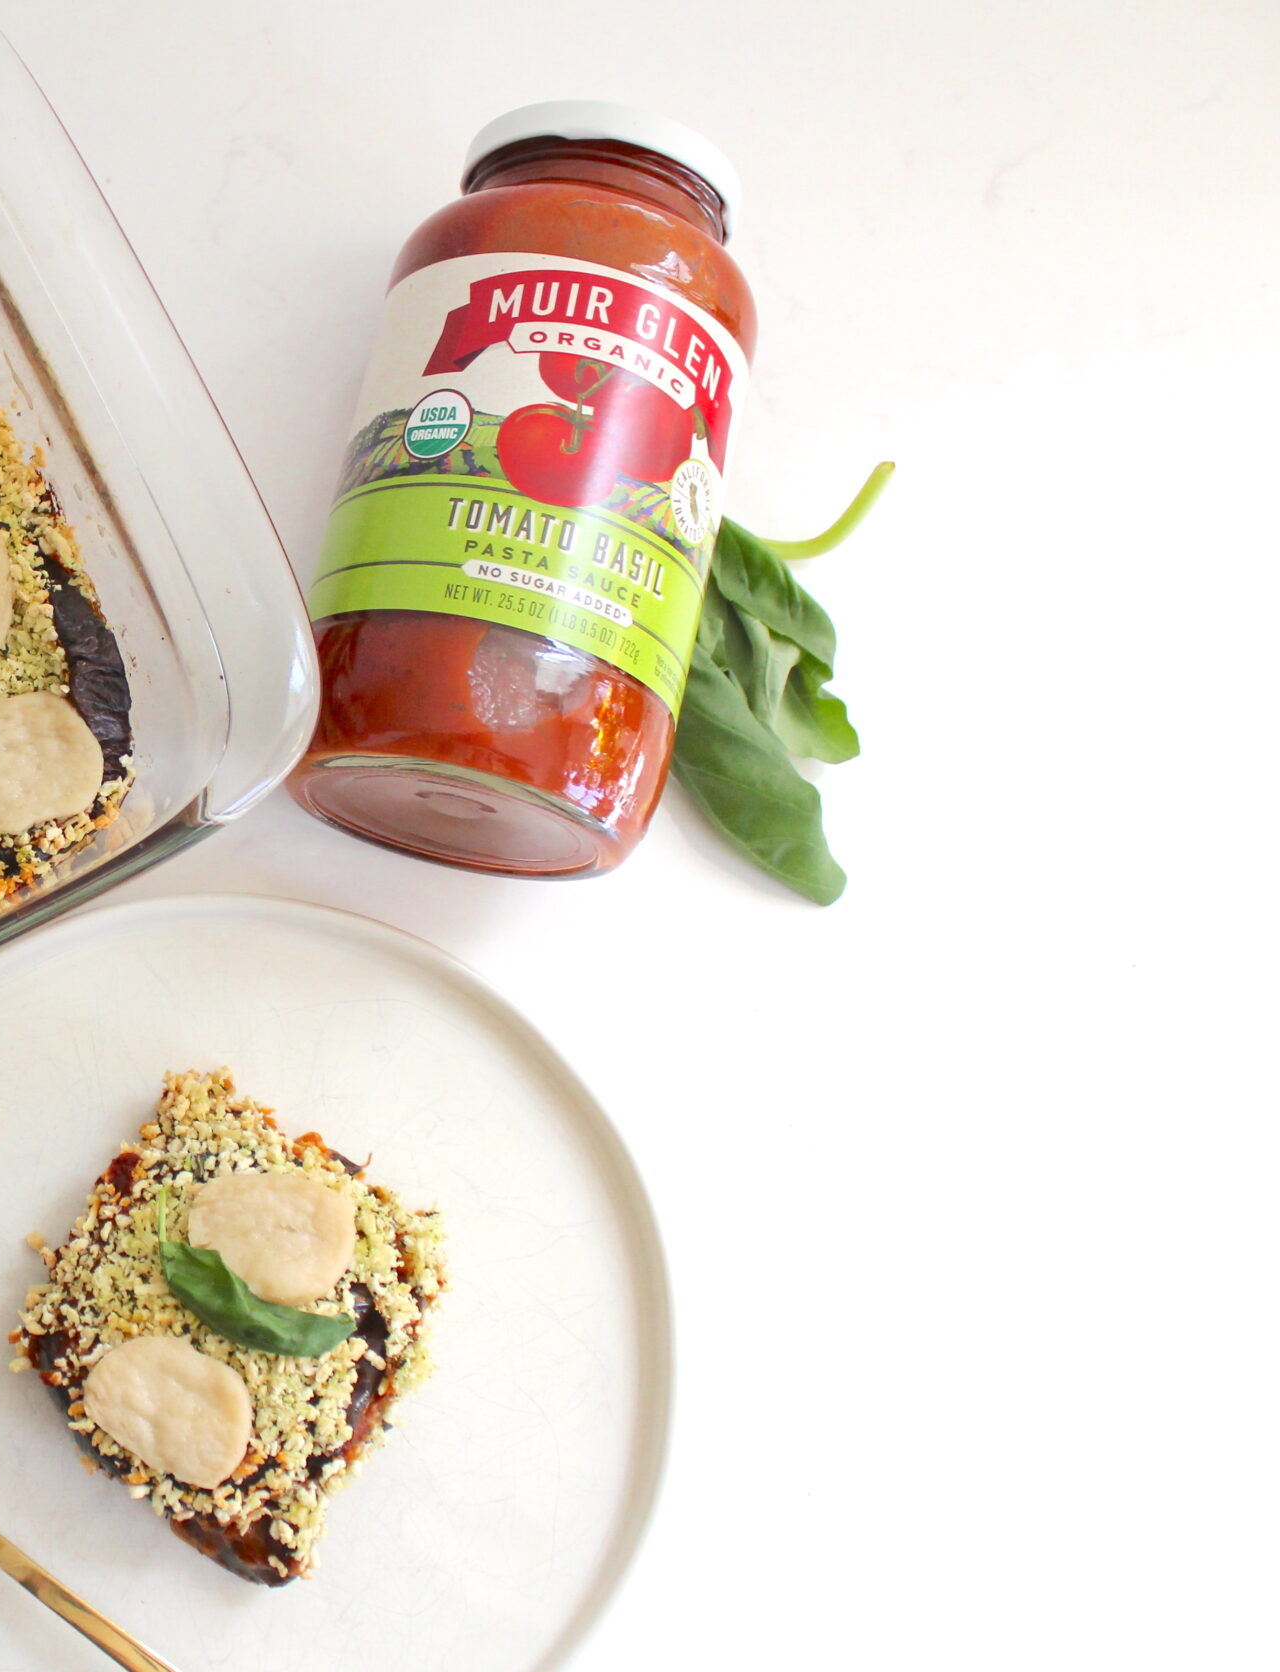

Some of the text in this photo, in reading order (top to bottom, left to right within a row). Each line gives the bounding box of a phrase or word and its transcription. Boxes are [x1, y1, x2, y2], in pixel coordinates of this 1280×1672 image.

[488, 282, 721, 401] MUIR GLEN
[529, 331, 684, 395] ORGANIC
[411, 427, 458, 441] ORGANIC
[420, 406, 457, 422] USDA
[448, 497, 664, 599] TOMATO BASIL
[464, 540, 641, 609] PASTA SAUCE
[478, 564, 501, 578] NO
[510, 572, 567, 596] SUGAR
[444, 584, 468, 601] NET
[472, 588, 493, 606] WT.
[498, 593, 525, 613] 25.5
[529, 603, 545, 619] OZ
[562, 611, 576, 630] LB
[579, 619, 598, 640] 9.5
[599, 627, 618, 649] OZ)
[620, 636, 640, 665] 722g
